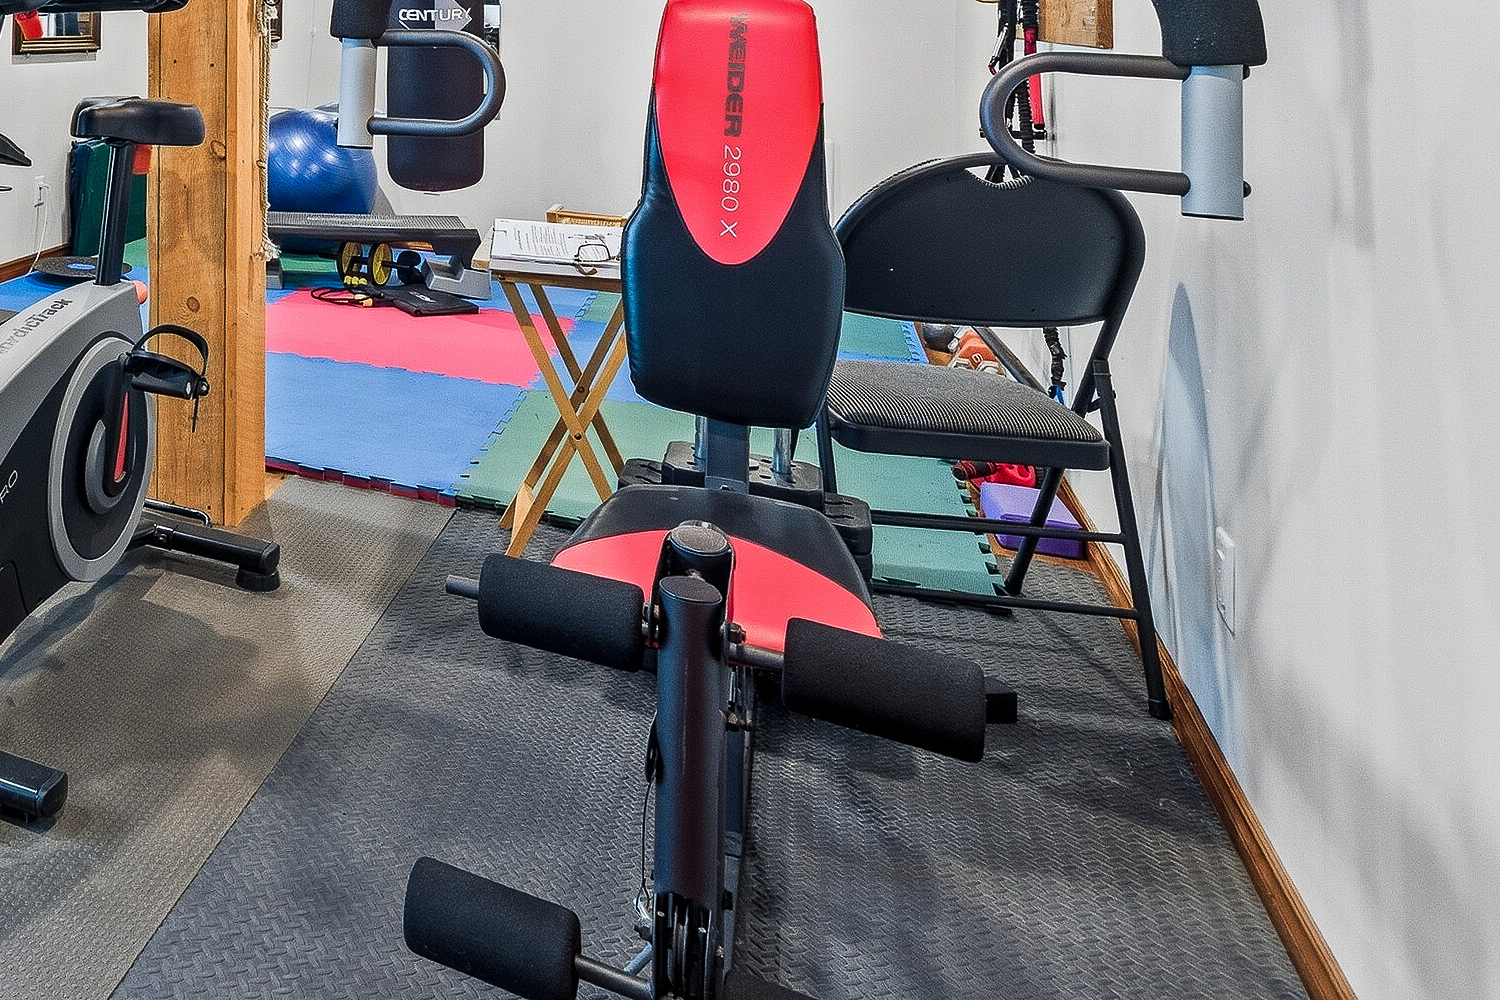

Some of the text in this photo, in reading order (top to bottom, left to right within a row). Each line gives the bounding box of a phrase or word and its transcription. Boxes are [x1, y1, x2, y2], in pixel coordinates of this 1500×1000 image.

[398, 7, 472, 22] CENTURY
[719, 12, 748, 238] WEIDER 2980 X
